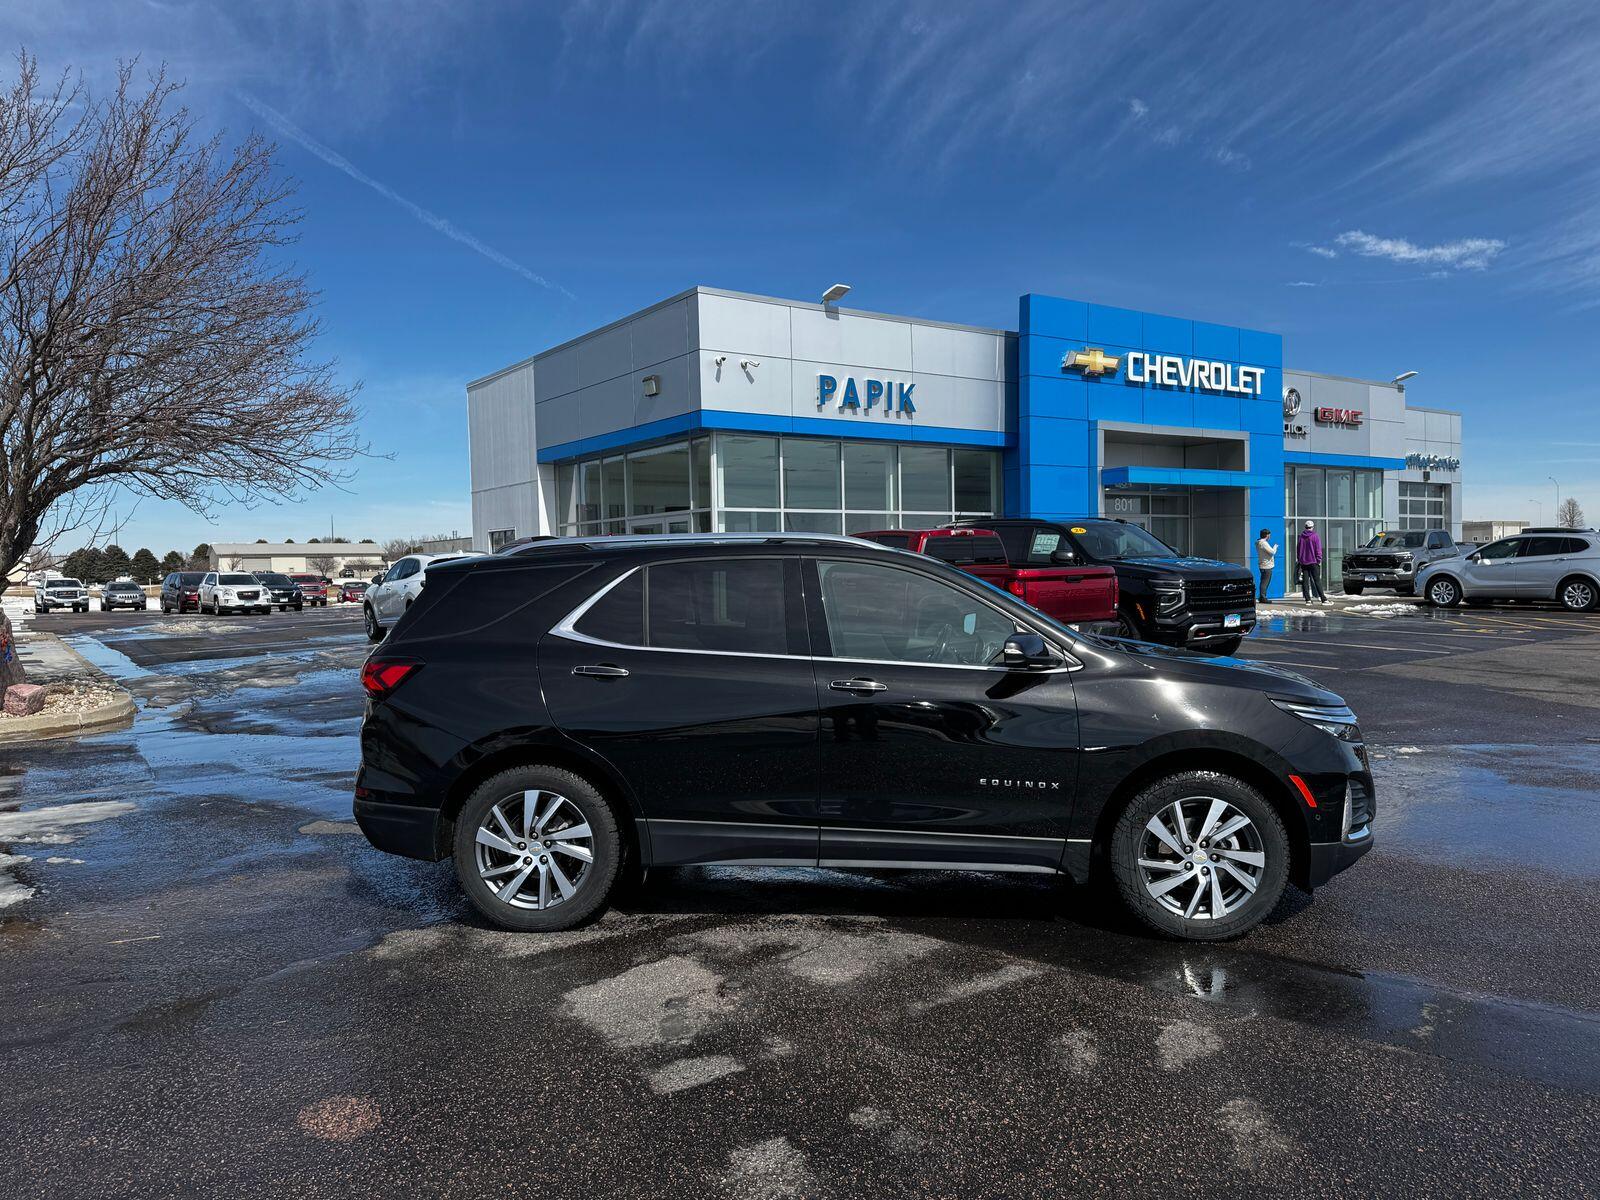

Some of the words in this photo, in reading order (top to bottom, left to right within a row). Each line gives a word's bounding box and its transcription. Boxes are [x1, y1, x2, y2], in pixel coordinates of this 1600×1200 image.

[1127, 351, 1265, 395] CHEVROLET
[817, 374, 917, 413] PAPIK
[1318, 407, 1363, 425] GMC
[1283, 423, 1309, 435] UICK
[1114, 498, 1133, 511] 801
[980, 778, 1060, 790] EQUINOX
